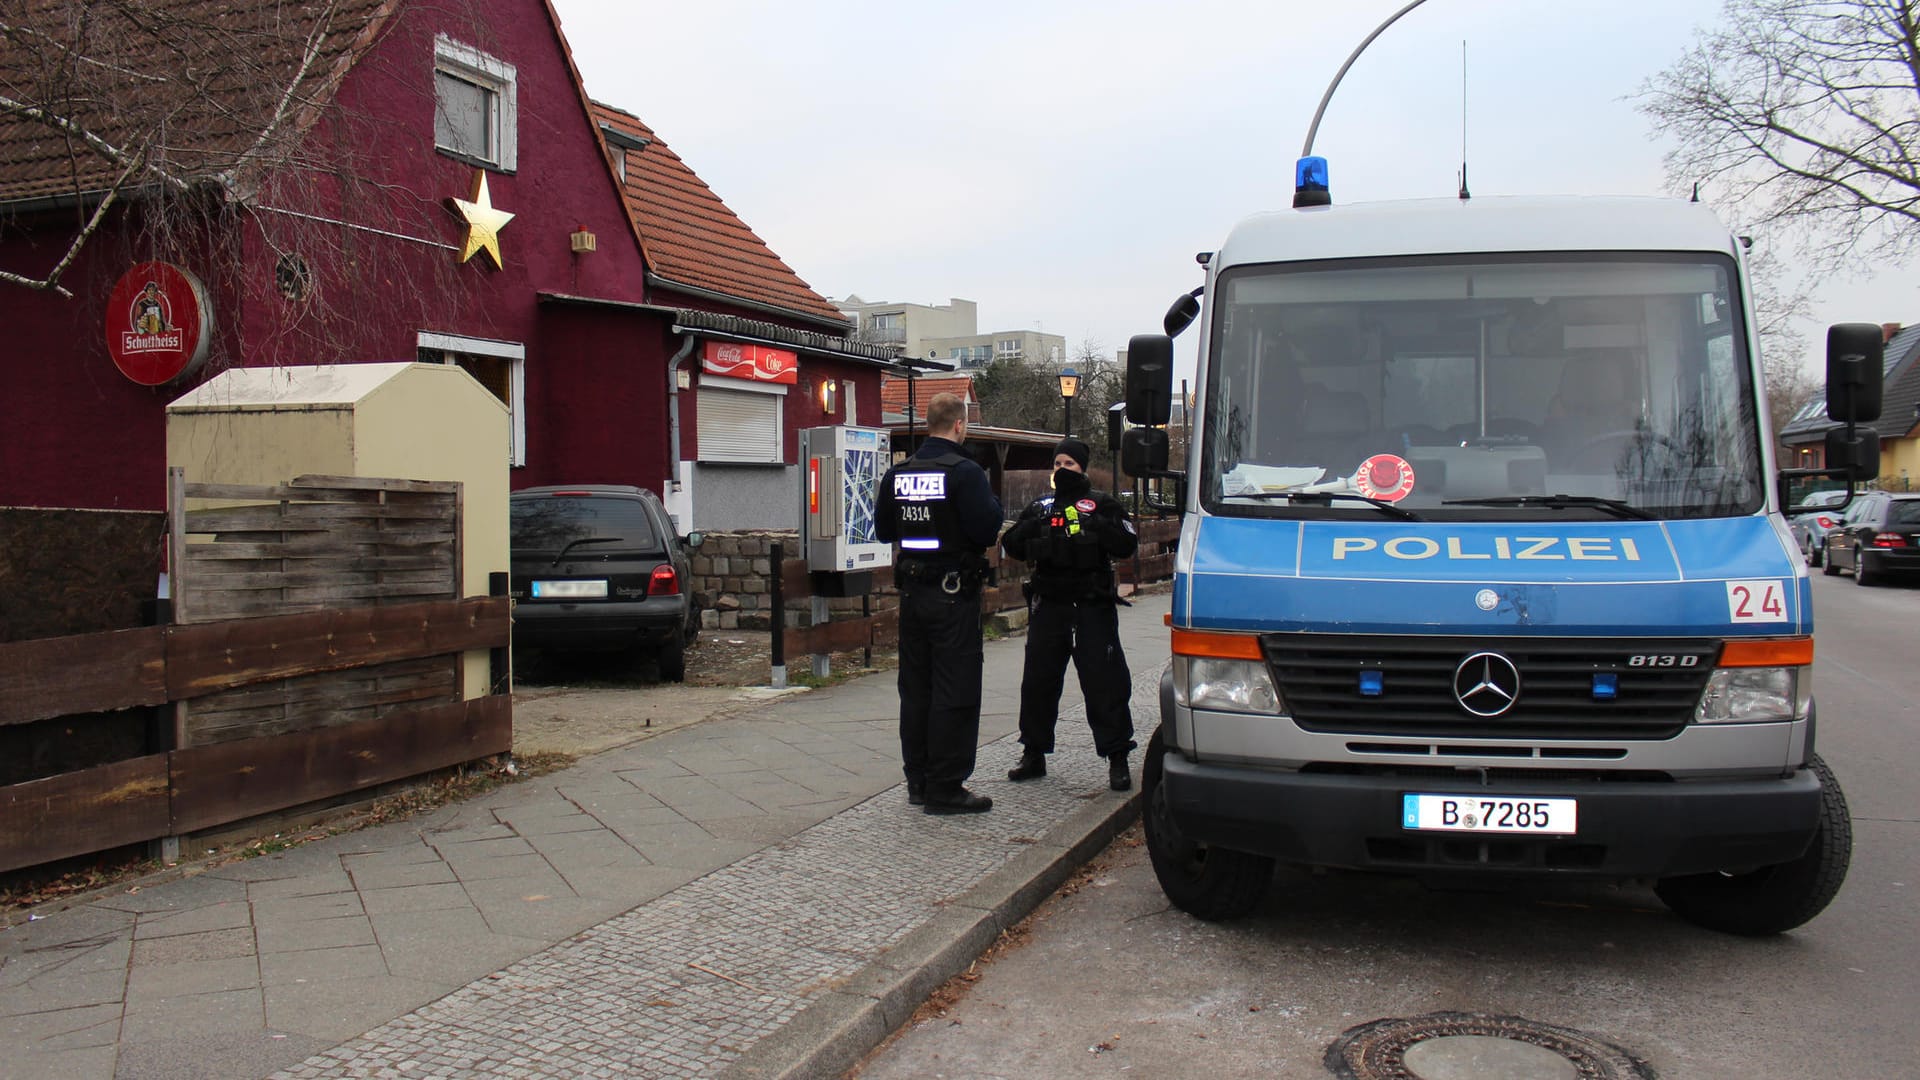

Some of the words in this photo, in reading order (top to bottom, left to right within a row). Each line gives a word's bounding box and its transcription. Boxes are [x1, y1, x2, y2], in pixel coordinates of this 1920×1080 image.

[126, 334, 179, 349] Schultheiss
[766, 354, 782, 372] Coke
[894, 476, 945, 496] POLIZEI
[901, 506, 930, 521] 24314
[1332, 537, 1641, 561] POLIZEI
[1733, 585, 1782, 617] 24
[1629, 655, 1676, 666] 813
[1680, 655, 1698, 666] D
[1442, 801, 1459, 825] B
[1480, 802, 1550, 828] 7285
